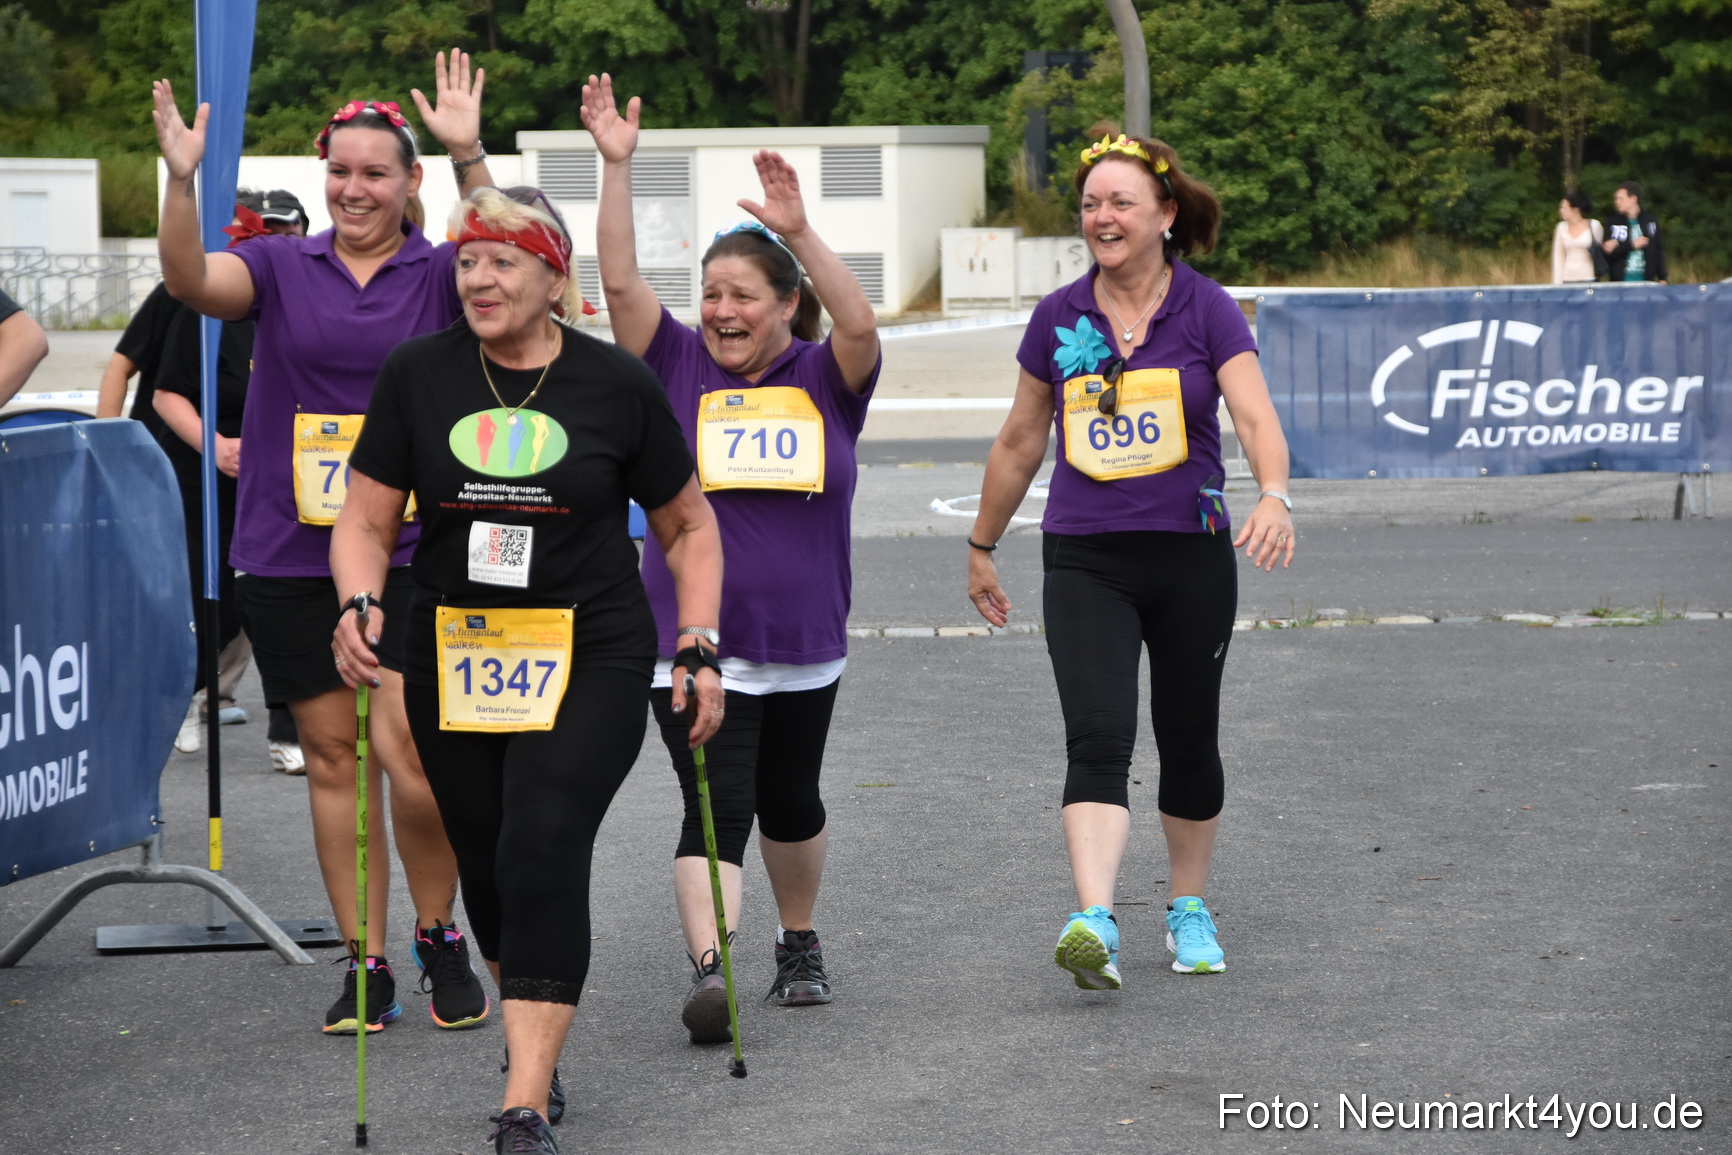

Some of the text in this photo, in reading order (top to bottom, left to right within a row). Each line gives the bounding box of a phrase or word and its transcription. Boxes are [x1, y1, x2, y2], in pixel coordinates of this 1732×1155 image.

[1431, 364, 1705, 419] Fischer
[1088, 411, 1161, 451] 696
[1454, 421, 1682, 449] AUTOMOBILE
[723, 427, 798, 460] 710
[1101, 456, 1127, 465] Regina
[727, 466, 747, 474] Petra
[463, 481, 546, 495] Selbsthilfegruppe-
[457, 491, 553, 503] Adipositas-Neumarkt
[439, 501, 570, 514] www.shg-adipositas-neumarkt.de
[457, 627, 505, 638] firmenlauf
[445, 640, 484, 650] walken
[454, 656, 558, 698] 1347
[475, 704, 531, 715] Barbara Frenzel
